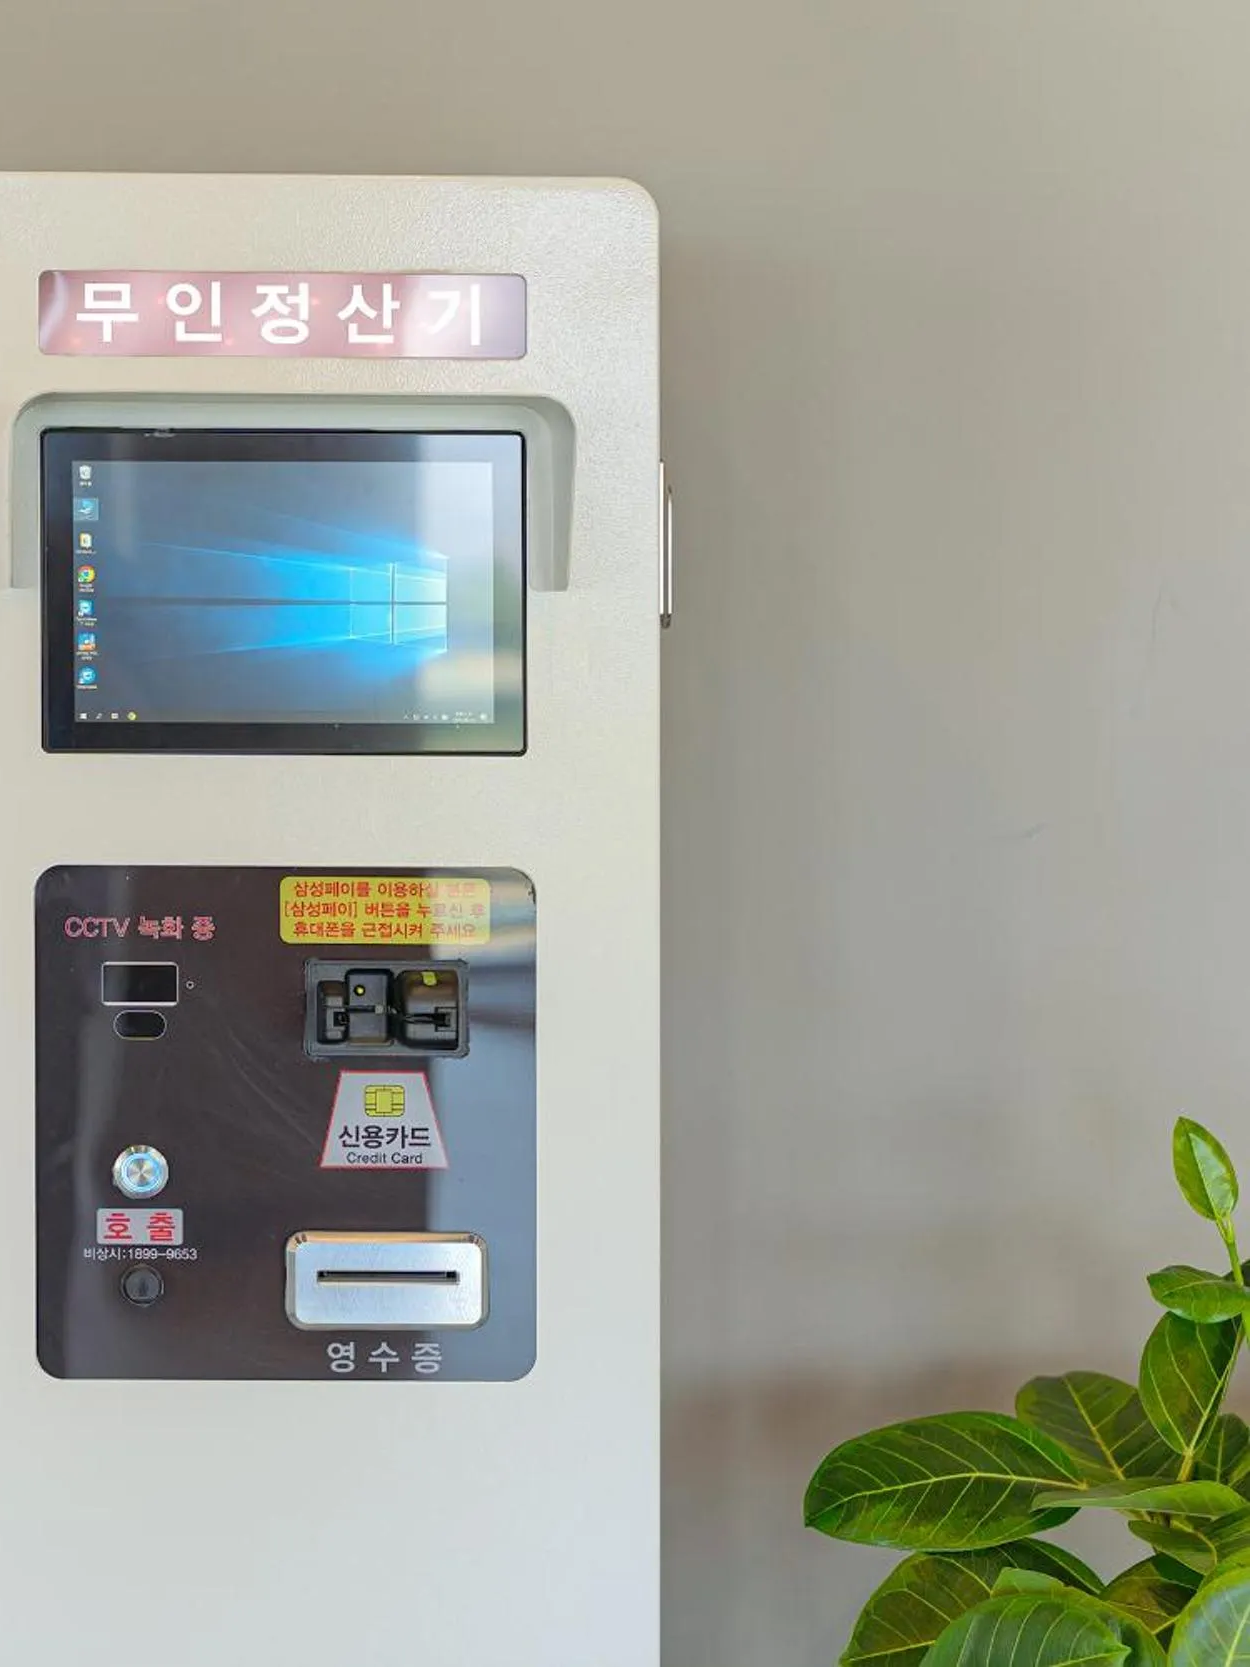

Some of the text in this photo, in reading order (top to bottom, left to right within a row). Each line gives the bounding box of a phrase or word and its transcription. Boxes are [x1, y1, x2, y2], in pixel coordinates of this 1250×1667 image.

[76, 279, 482, 346] 무인정산기
[293, 881, 370, 898] 삼성페이를
[284, 901, 357, 918] [삼성페이]
[365, 901, 410, 918] 버튼을
[64, 915, 216, 941] CCTV 녹화 중
[293, 922, 477, 939] 휴대폰을 근접시켜 주세요
[338, 1125, 431, 1149] 신용카드
[346, 1151, 423, 1165] Credit Card
[104, 1212, 176, 1242] 호출
[326, 1341, 443, 1374] 영수증
